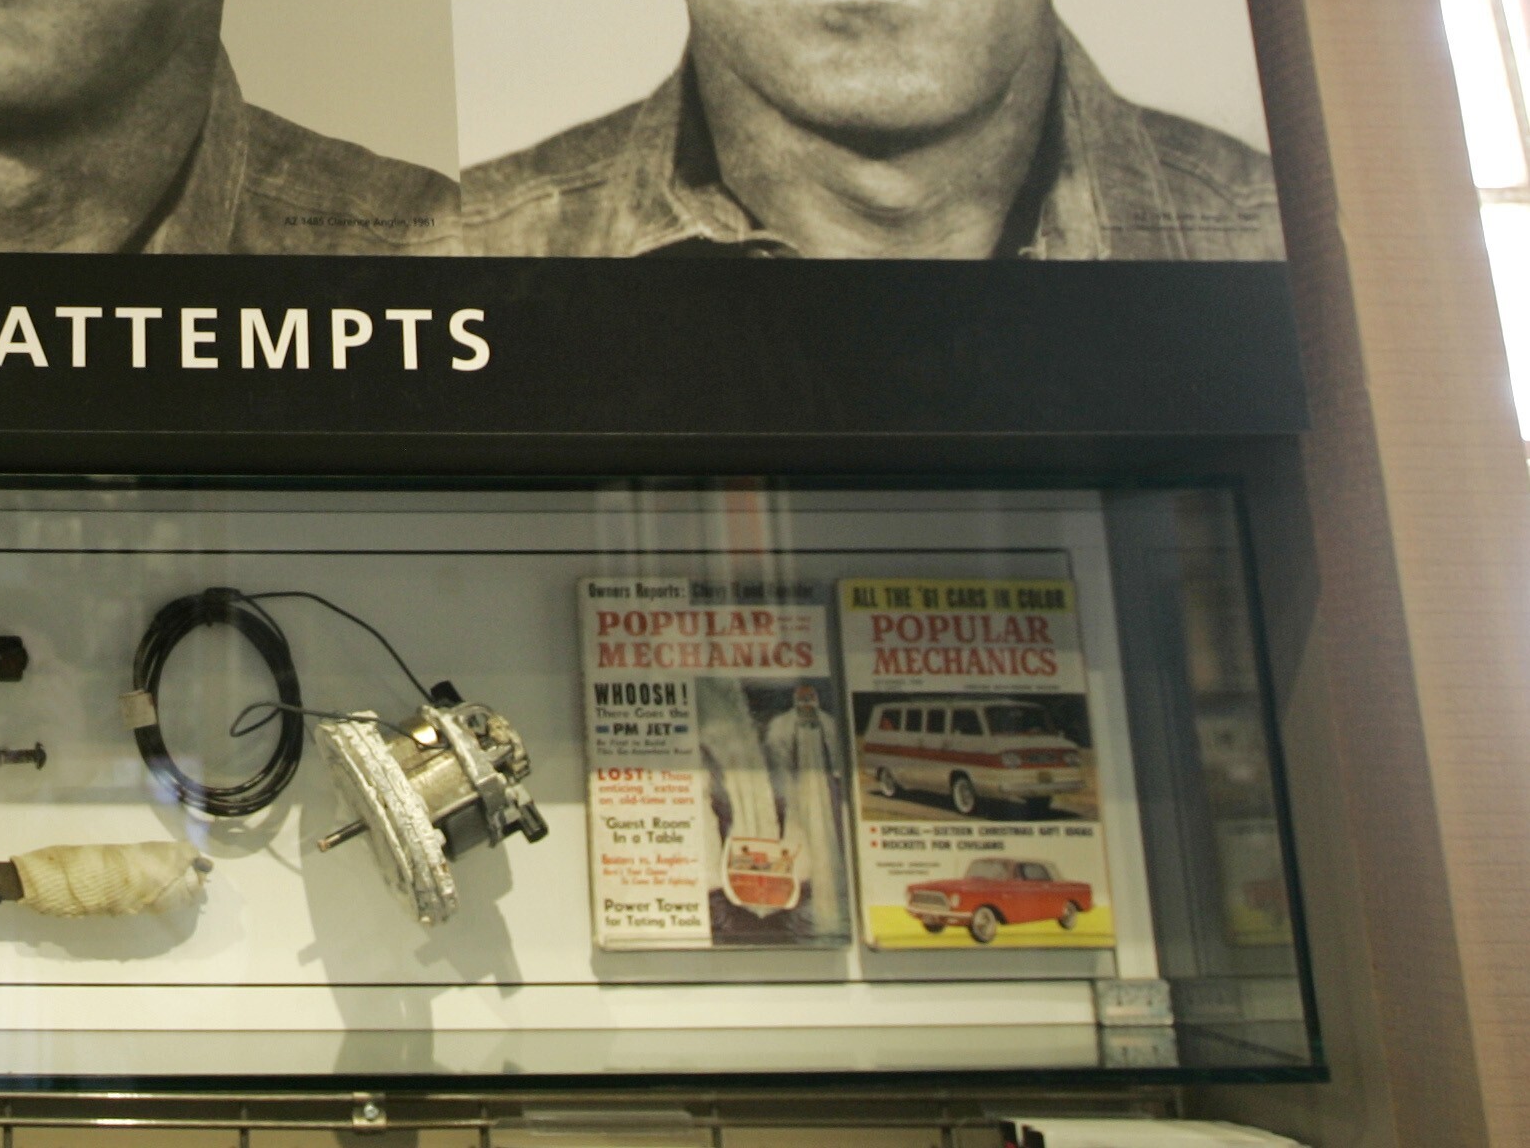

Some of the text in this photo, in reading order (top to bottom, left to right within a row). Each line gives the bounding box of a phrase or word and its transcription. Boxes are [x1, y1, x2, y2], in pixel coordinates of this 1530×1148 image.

[588, 581, 630, 598] Owners
[852, 587, 878, 608] ALL
[884, 587, 912, 608] THE
[946, 588, 987, 609] CARS
[993, 589, 1012, 608] IN
[1016, 588, 1066, 609] COLOR
[596, 610, 774, 637] POPULAR
[871, 614, 1053, 644] POPULAR
[598, 641, 814, 668] MECHANICS
[873, 647, 1058, 676] MECHANICS
[596, 708, 690, 719] There Goes the
[613, 723, 673, 736] PM JET
[648, 831, 684, 843] Table
[978, 826, 1033, 837] CHRISTMAS
[882, 839, 926, 850] ROCKETS
[932, 840, 951, 850] FOR
[605, 899, 699, 912] Power Tower
[605, 916, 621, 927] for
[671, 916, 702, 927] Tools
